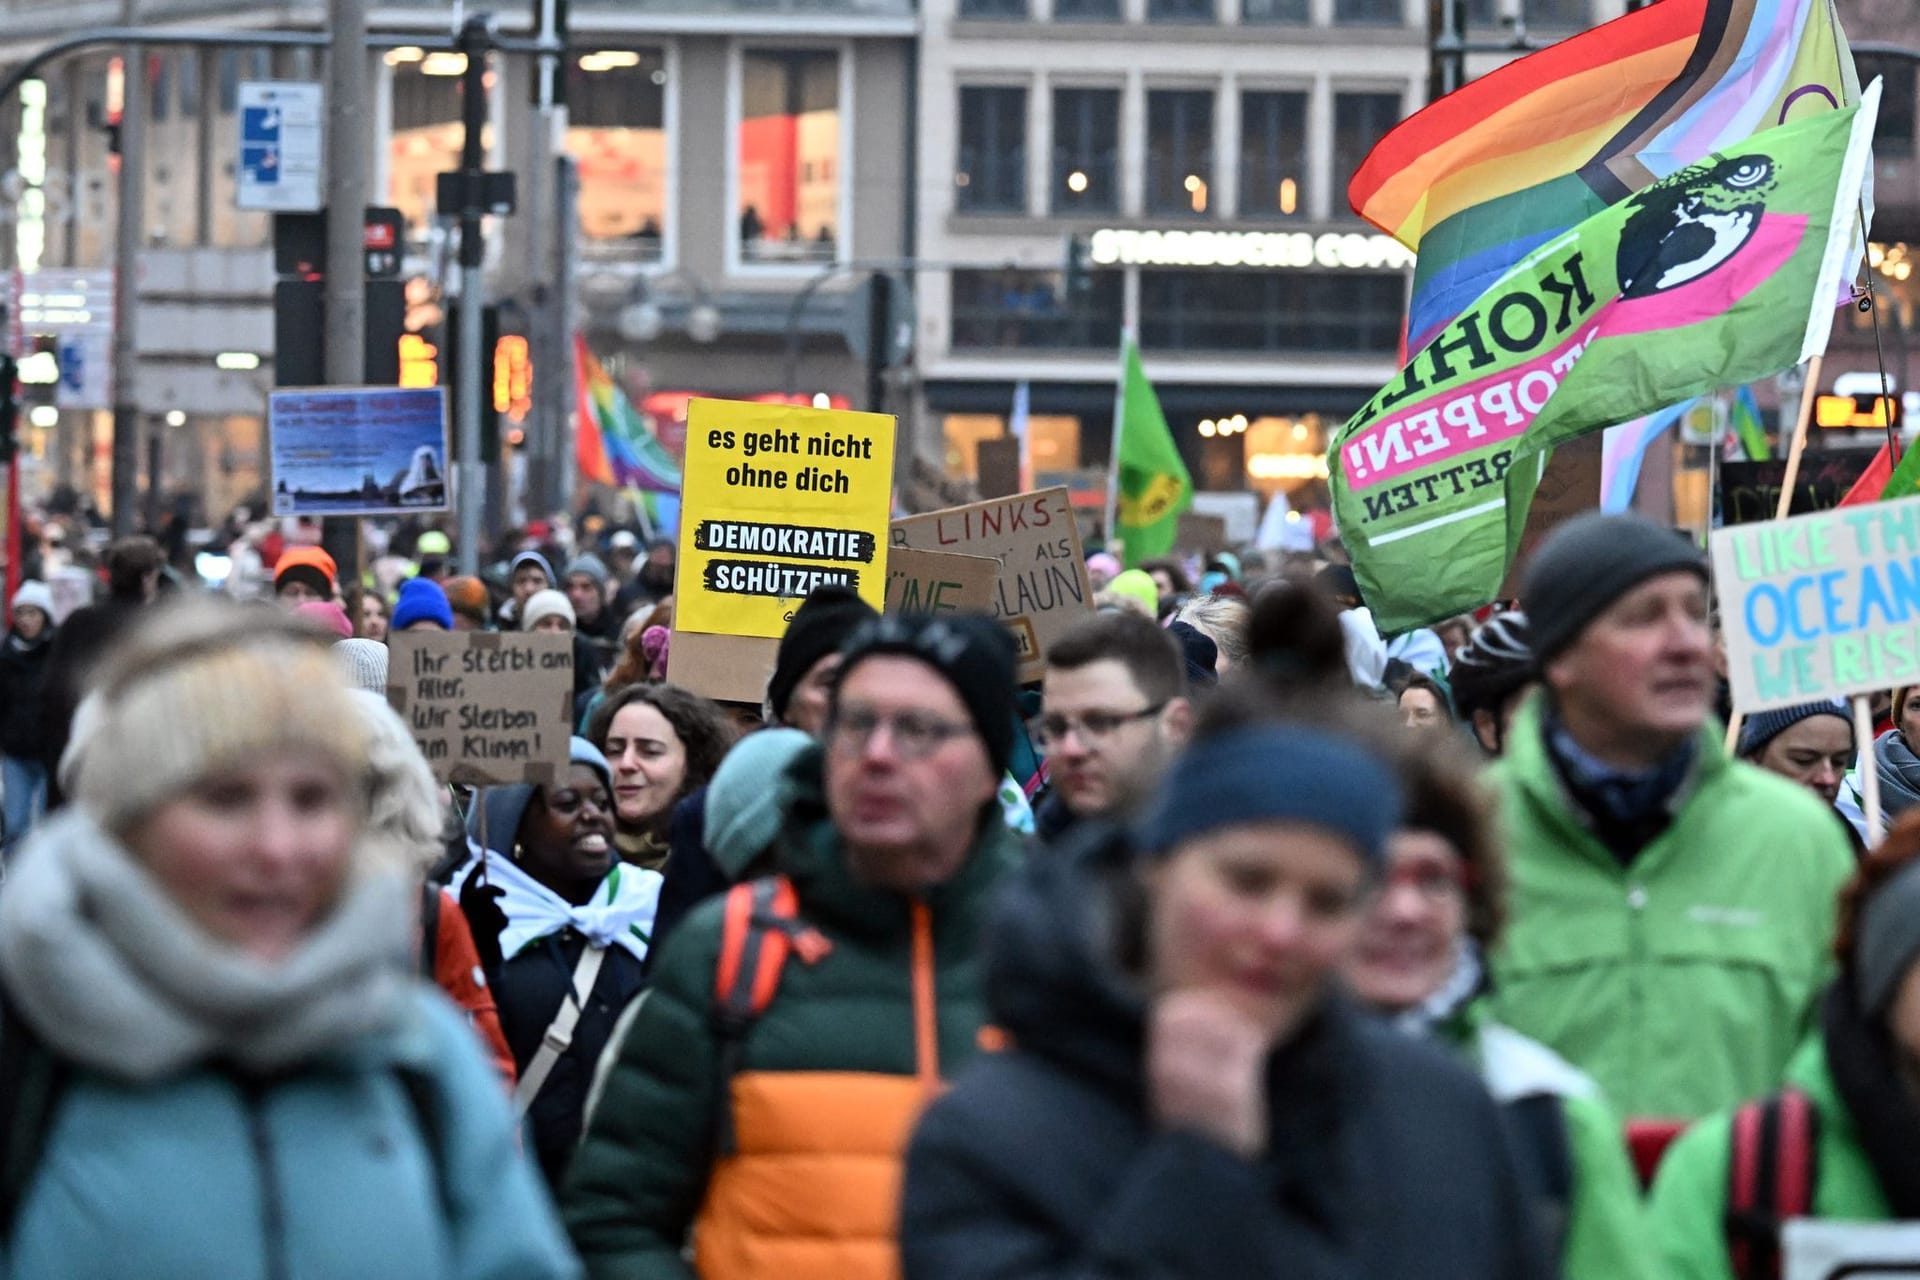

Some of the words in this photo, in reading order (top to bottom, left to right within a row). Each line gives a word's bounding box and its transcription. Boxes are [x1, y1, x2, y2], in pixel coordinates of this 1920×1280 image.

[708, 430, 736, 449] es
[743, 429, 800, 457] geht
[807, 432, 872, 459] nicht
[726, 463, 787, 489] ohne
[796, 467, 849, 494] dich
[709, 524, 860, 558] DEMOKRATIE
[1035, 538, 1071, 560] ALS
[1731, 519, 1836, 581] LIKE
[1844, 505, 1920, 557] TH
[993, 562, 1083, 618] LAUN
[414, 648, 449, 676] Ihr
[540, 651, 573, 669] am
[1753, 646, 1824, 700] WE
[1832, 628, 1920, 690] RIS
